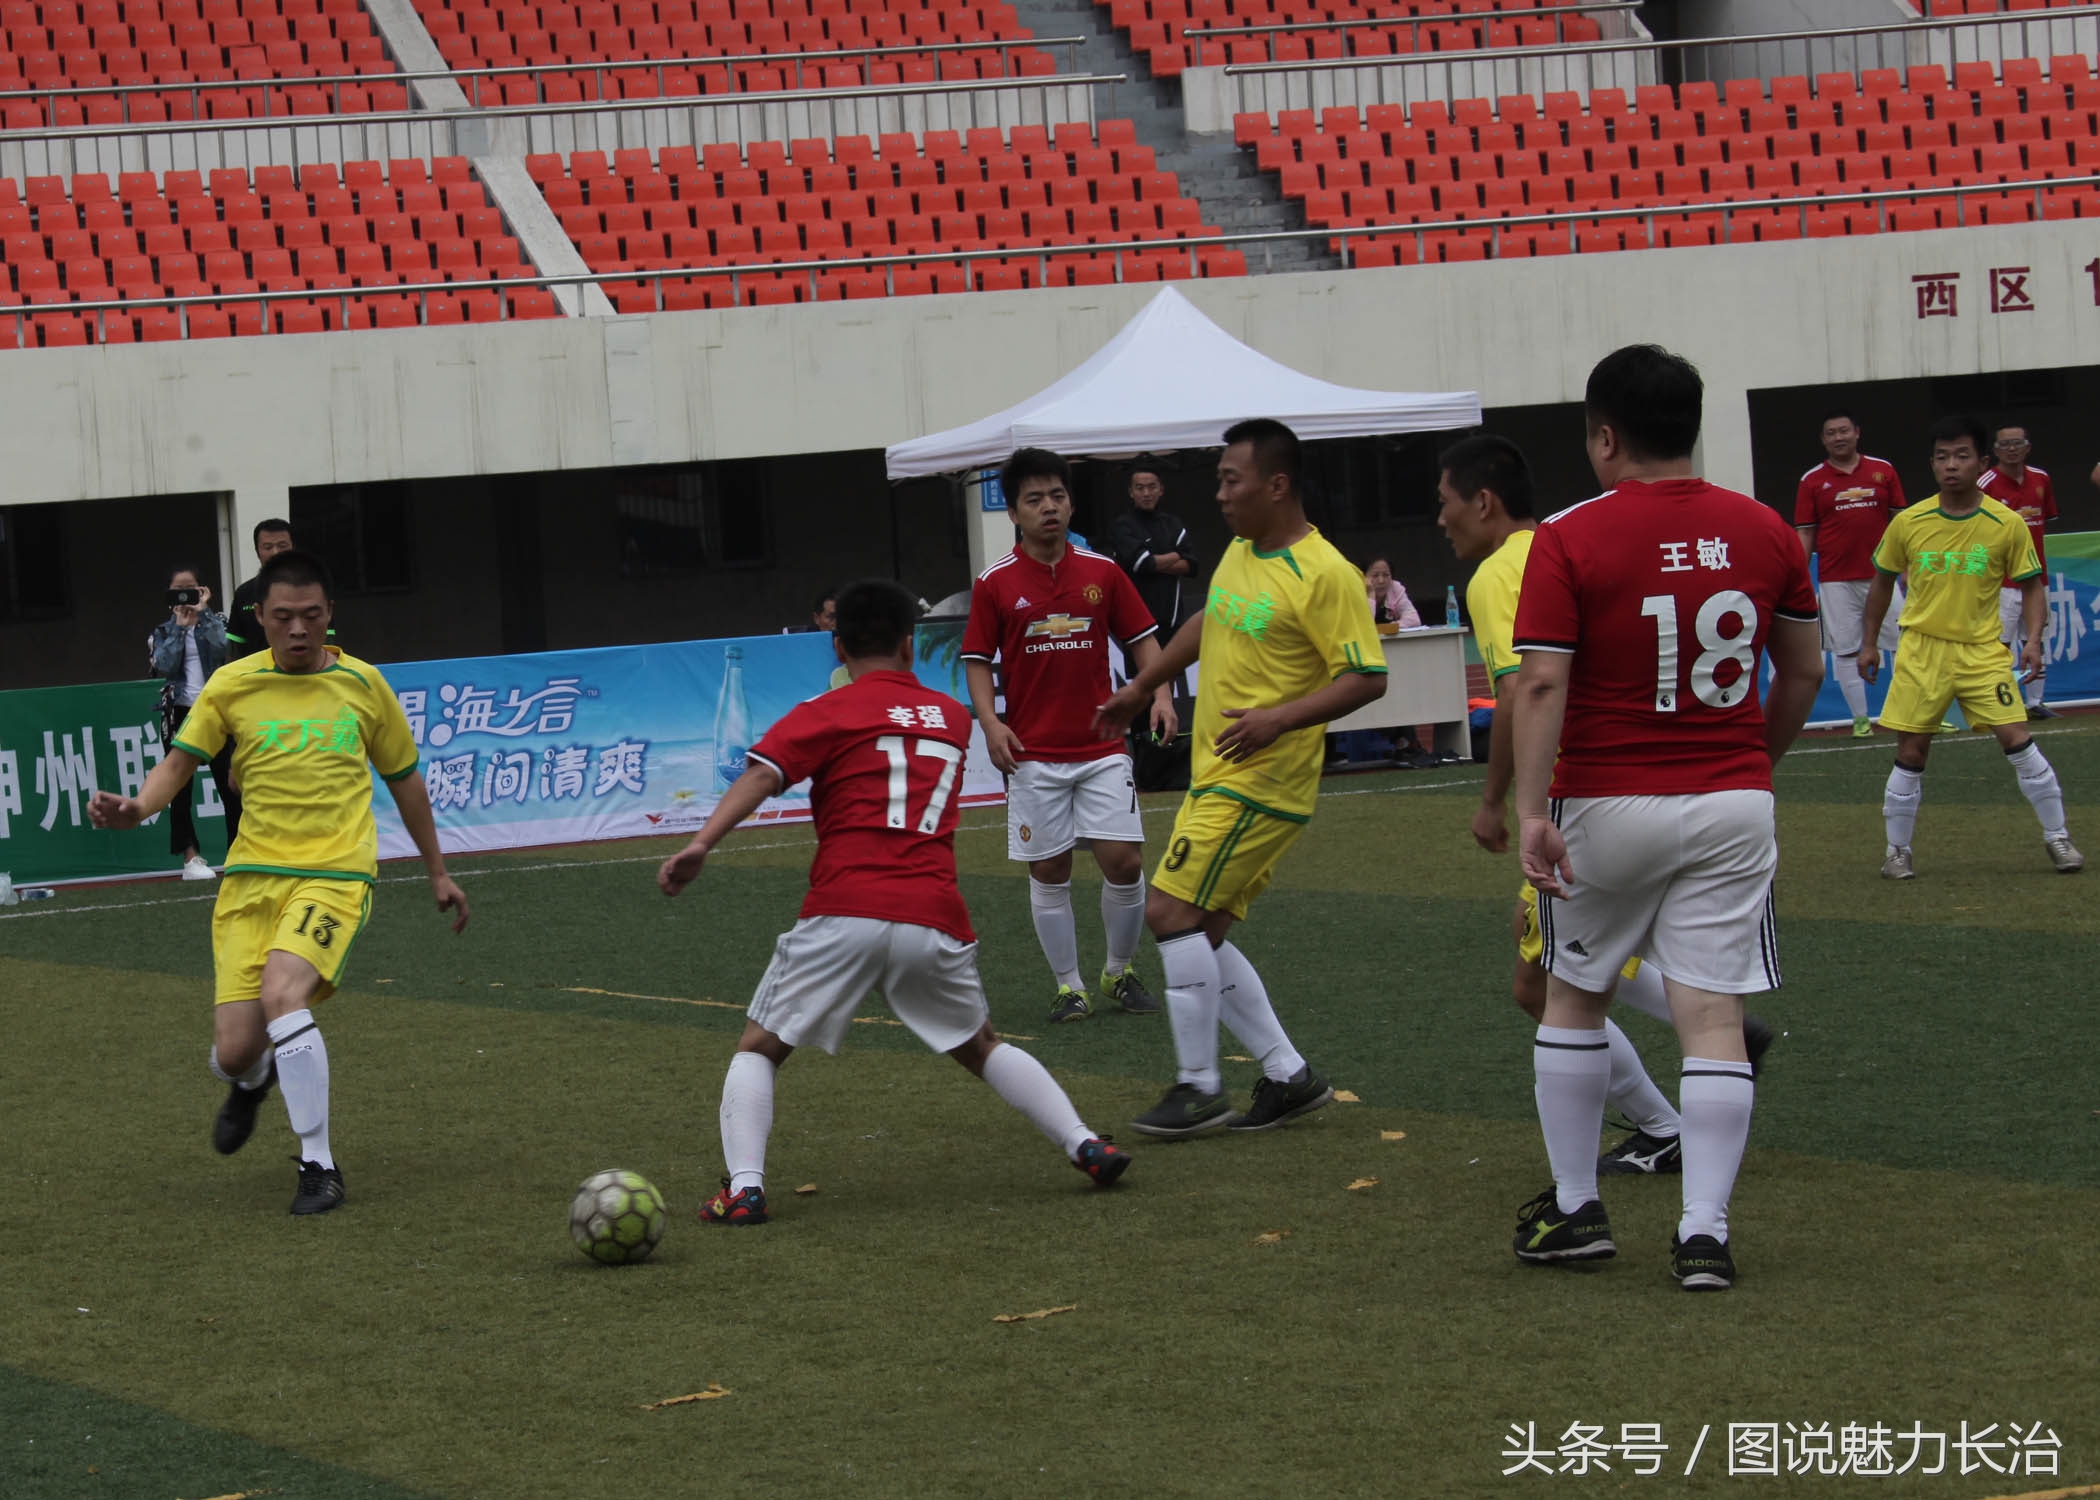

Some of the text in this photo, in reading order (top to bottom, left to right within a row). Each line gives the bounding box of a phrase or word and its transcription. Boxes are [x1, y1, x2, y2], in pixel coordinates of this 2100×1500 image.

[1911, 265, 2035, 320] 西区
[1834, 501, 1878, 511] CHEVROLET
[1658, 536, 1732, 573] 王敏
[1024, 640, 1094, 654] CHEVROLET
[1640, 589, 1759, 712] 18
[1995, 680, 2015, 707] 6
[424, 740, 646, 811] 瞬间清爽
[875, 735, 963, 835] 17
[1165, 835, 1191, 872] 9
[293, 903, 343, 950] 13
